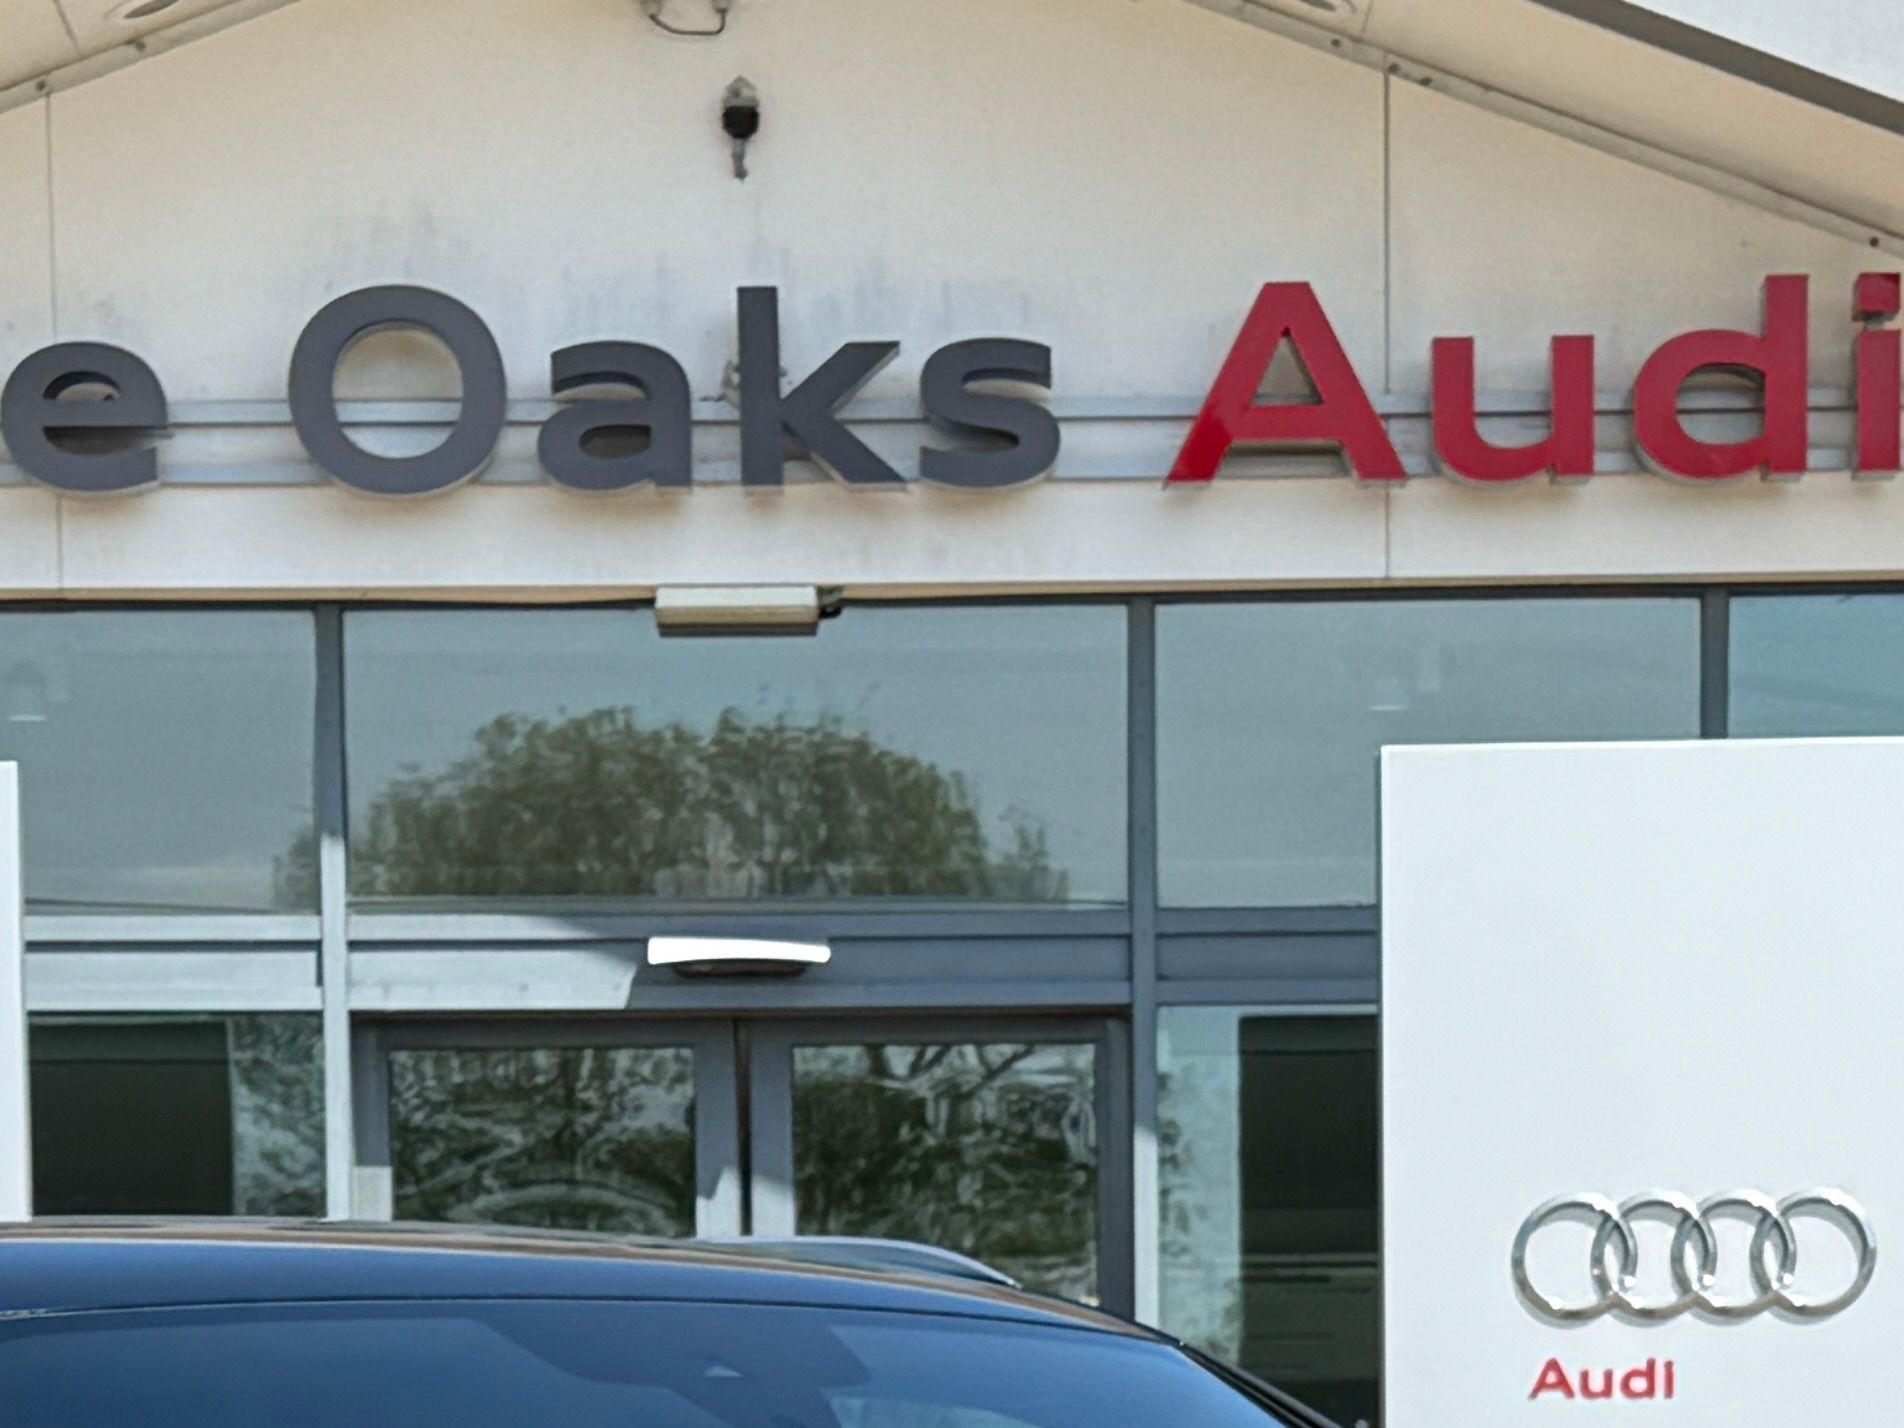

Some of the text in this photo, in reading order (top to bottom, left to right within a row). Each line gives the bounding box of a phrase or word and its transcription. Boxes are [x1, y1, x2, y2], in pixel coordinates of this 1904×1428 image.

[289, 284, 1061, 494] Oaks
[1163, 273, 1901, 488] Audi
[1528, 1357, 1674, 1400] Audi
